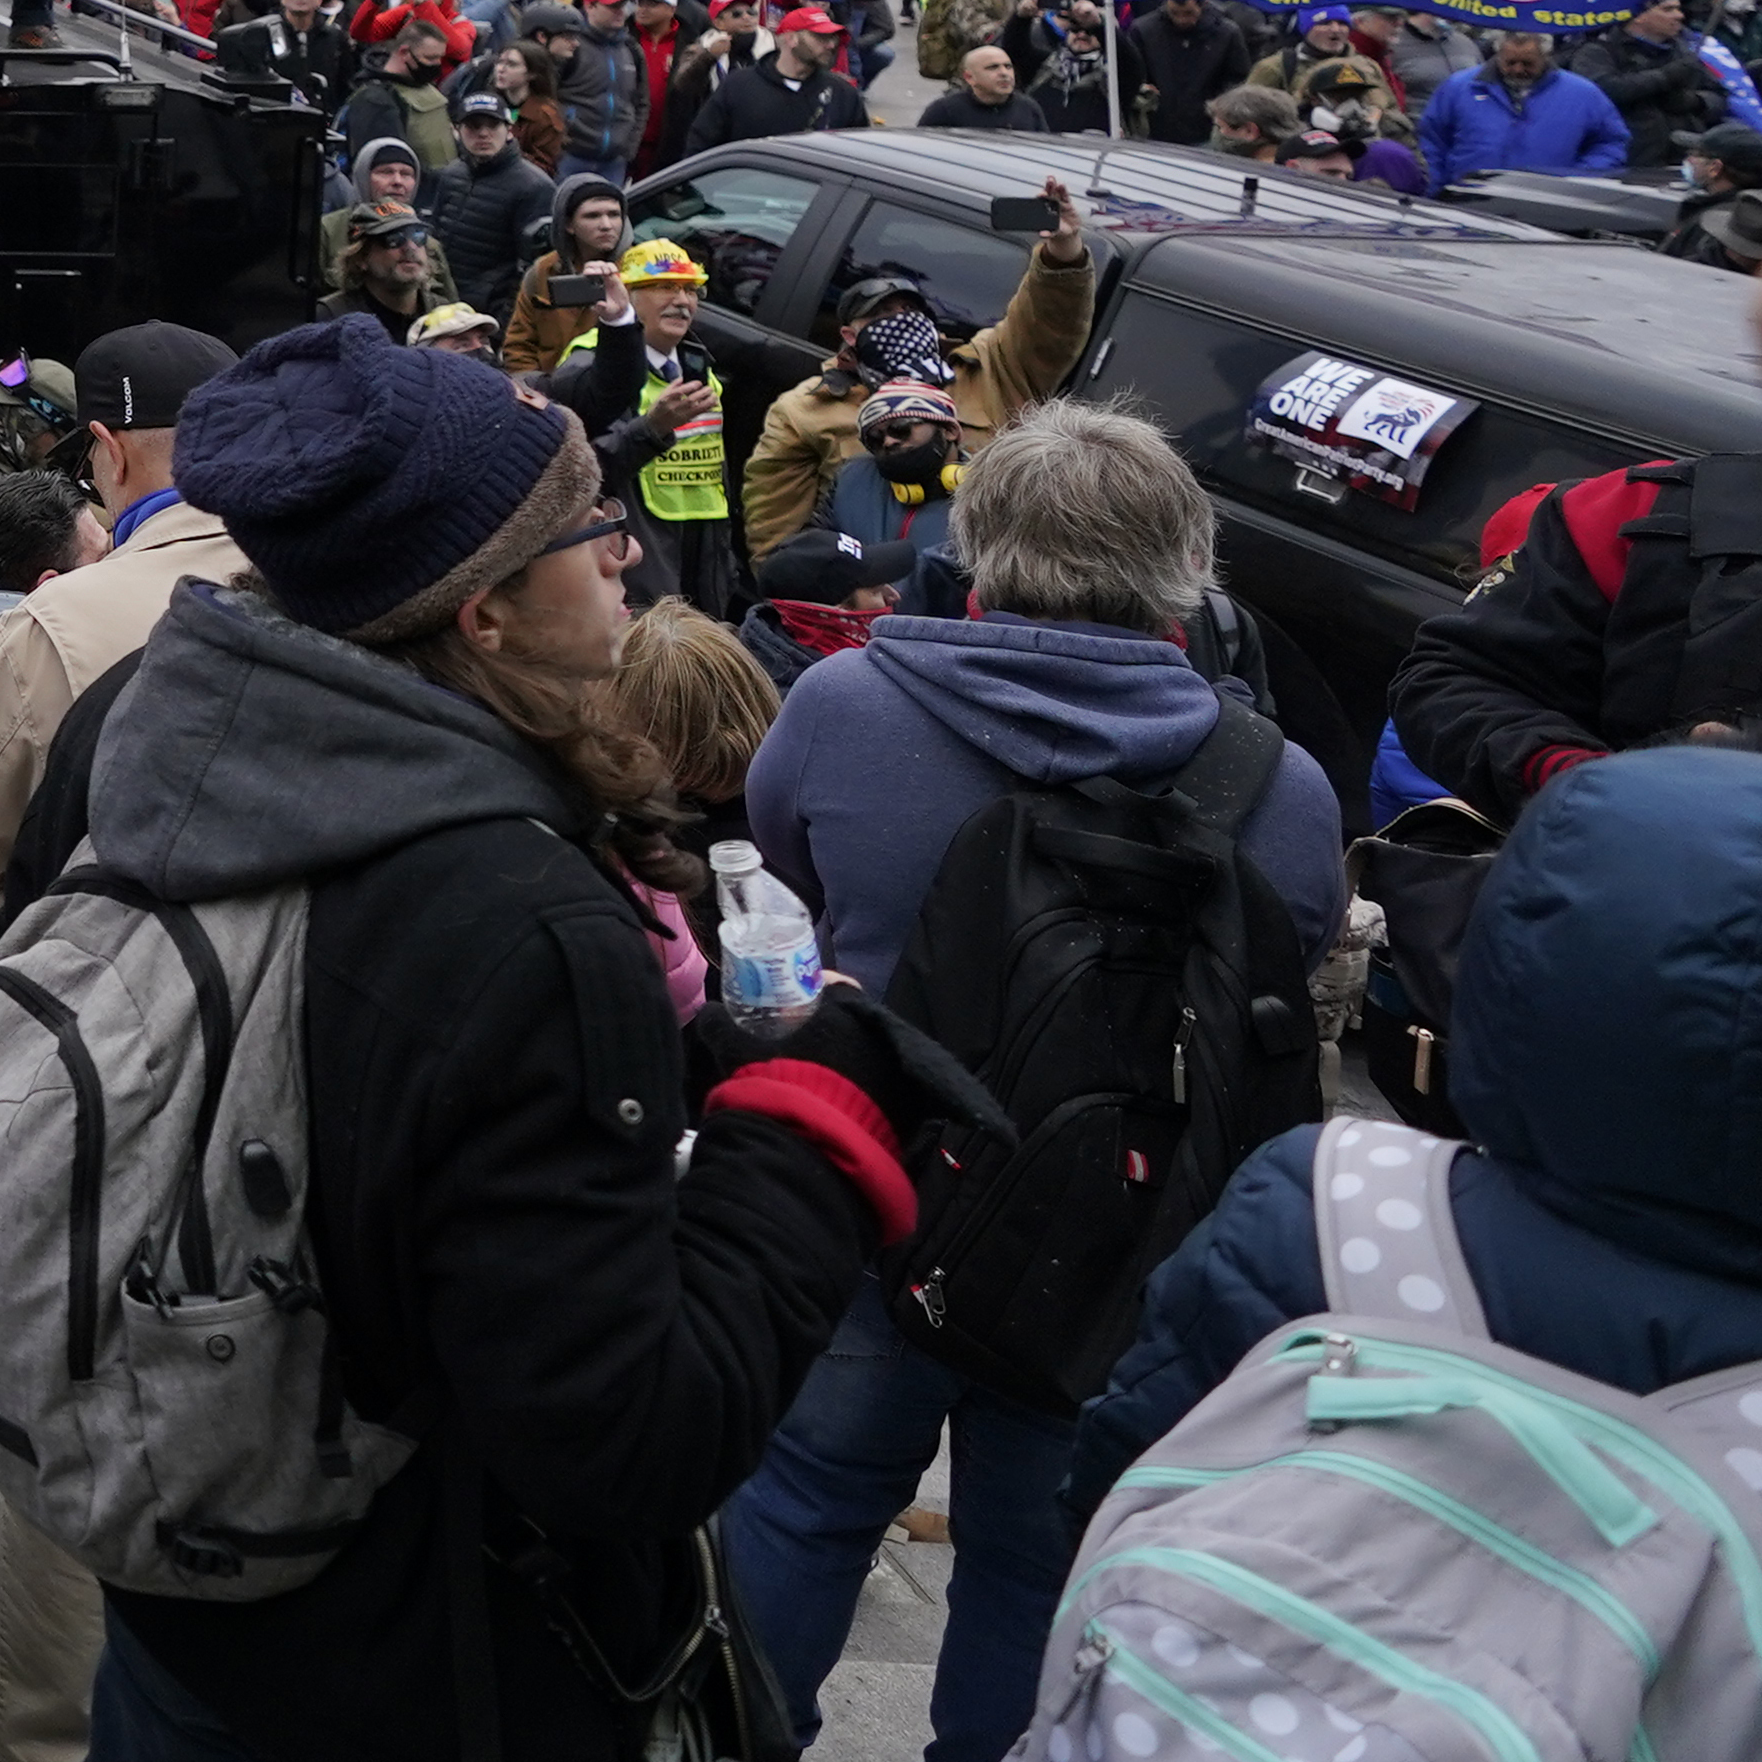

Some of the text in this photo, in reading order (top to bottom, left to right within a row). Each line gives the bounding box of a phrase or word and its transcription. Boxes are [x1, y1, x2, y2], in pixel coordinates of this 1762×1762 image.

[1303, 357, 1375, 389] WE
[122, 376, 133, 425] VOLCOM
[1269, 392, 1333, 432] ONE
[1280, 375, 1350, 411] ARE
